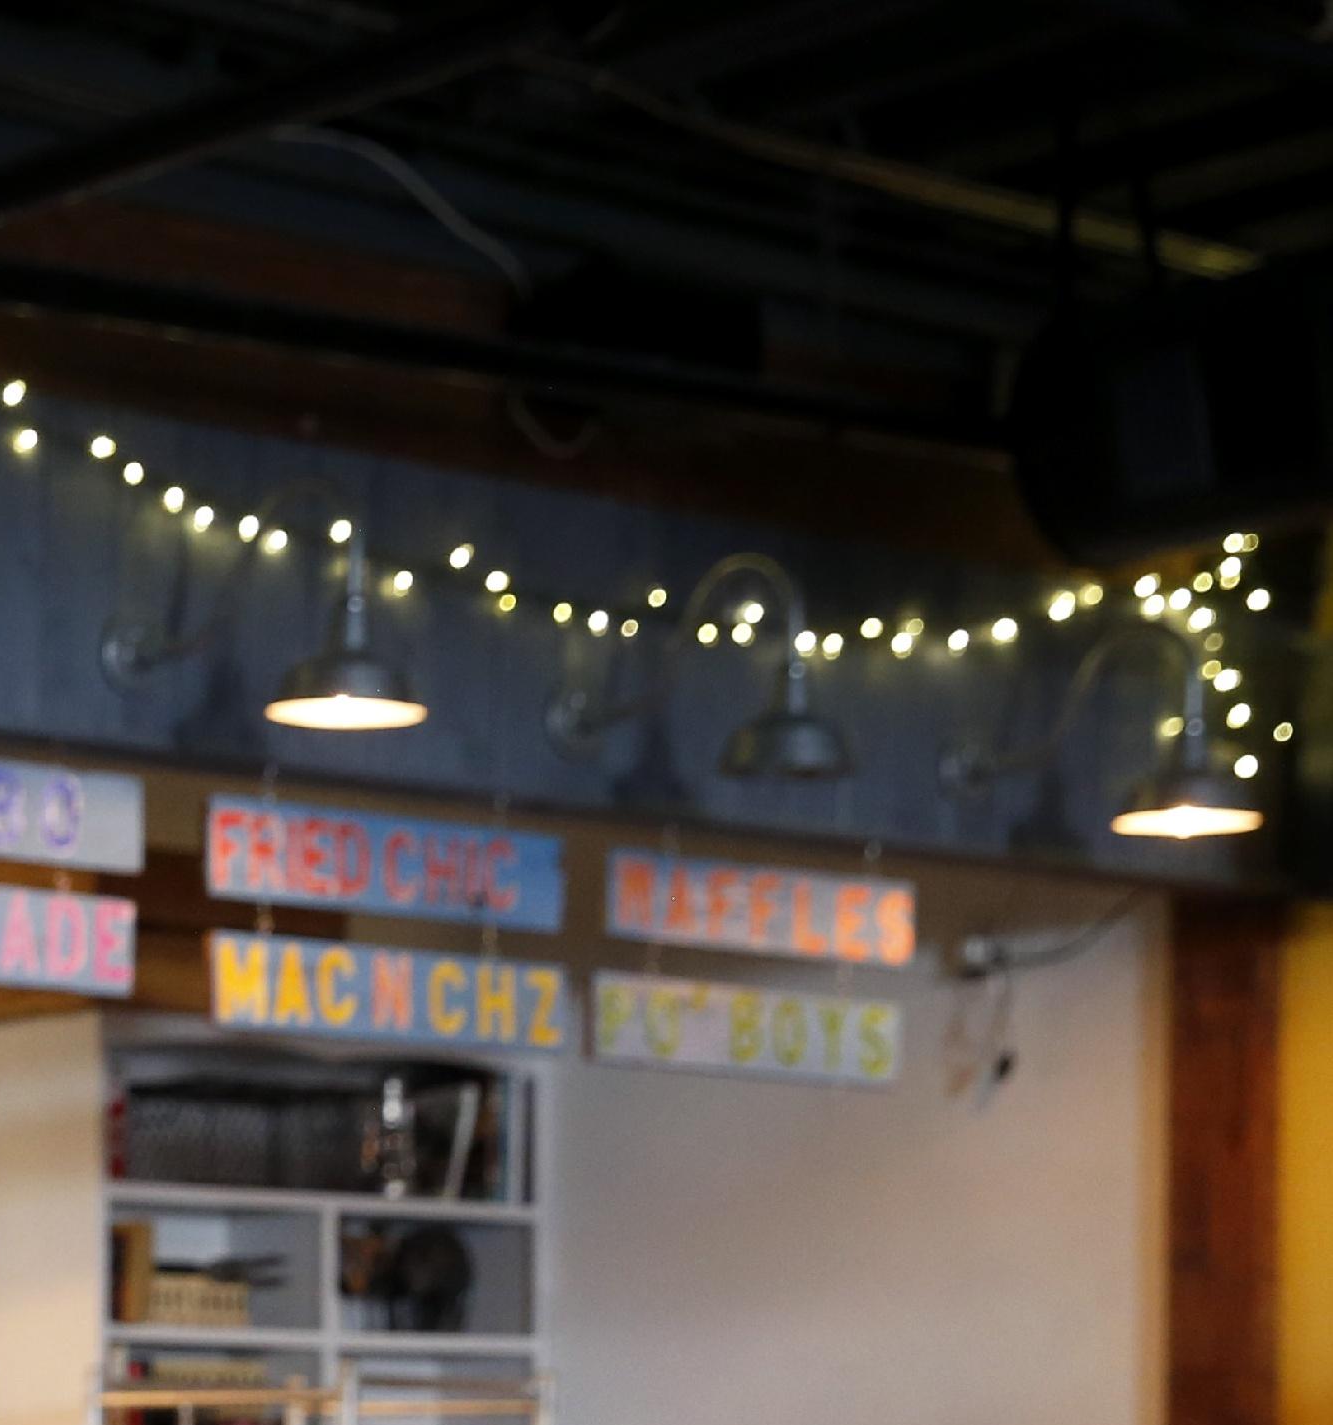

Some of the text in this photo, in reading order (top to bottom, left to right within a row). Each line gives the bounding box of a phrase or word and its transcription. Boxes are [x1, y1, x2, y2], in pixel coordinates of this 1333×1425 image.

[210, 809, 371, 898] FRIED
[215, 937, 564, 1047] MAC N CHZ
[729, 989, 895, 1079] BOYS
